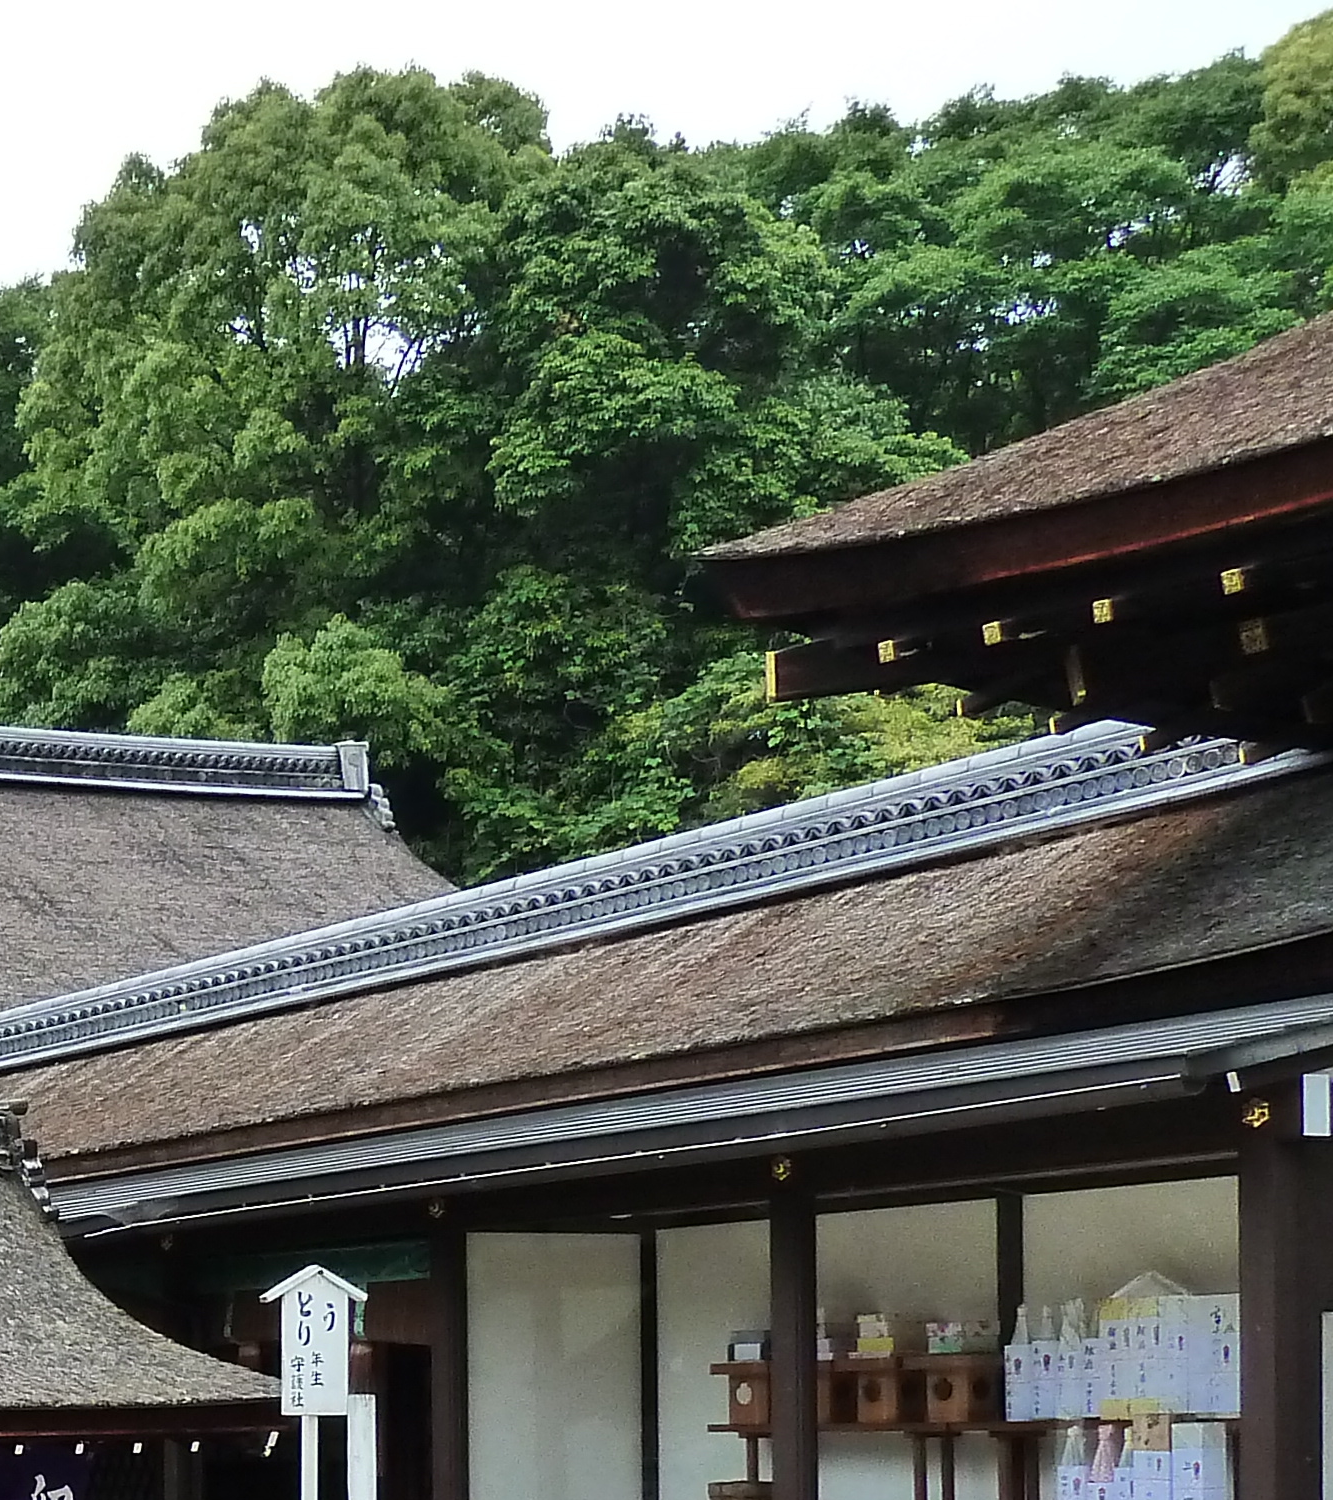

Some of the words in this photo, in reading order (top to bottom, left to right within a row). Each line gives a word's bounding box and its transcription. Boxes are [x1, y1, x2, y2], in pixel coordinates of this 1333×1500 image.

[297, 1291, 314, 1346] とり
[322, 1303, 336, 1332] う
[290, 1355, 306, 1407] 守護社
[310, 1351, 325, 1387] 年生
